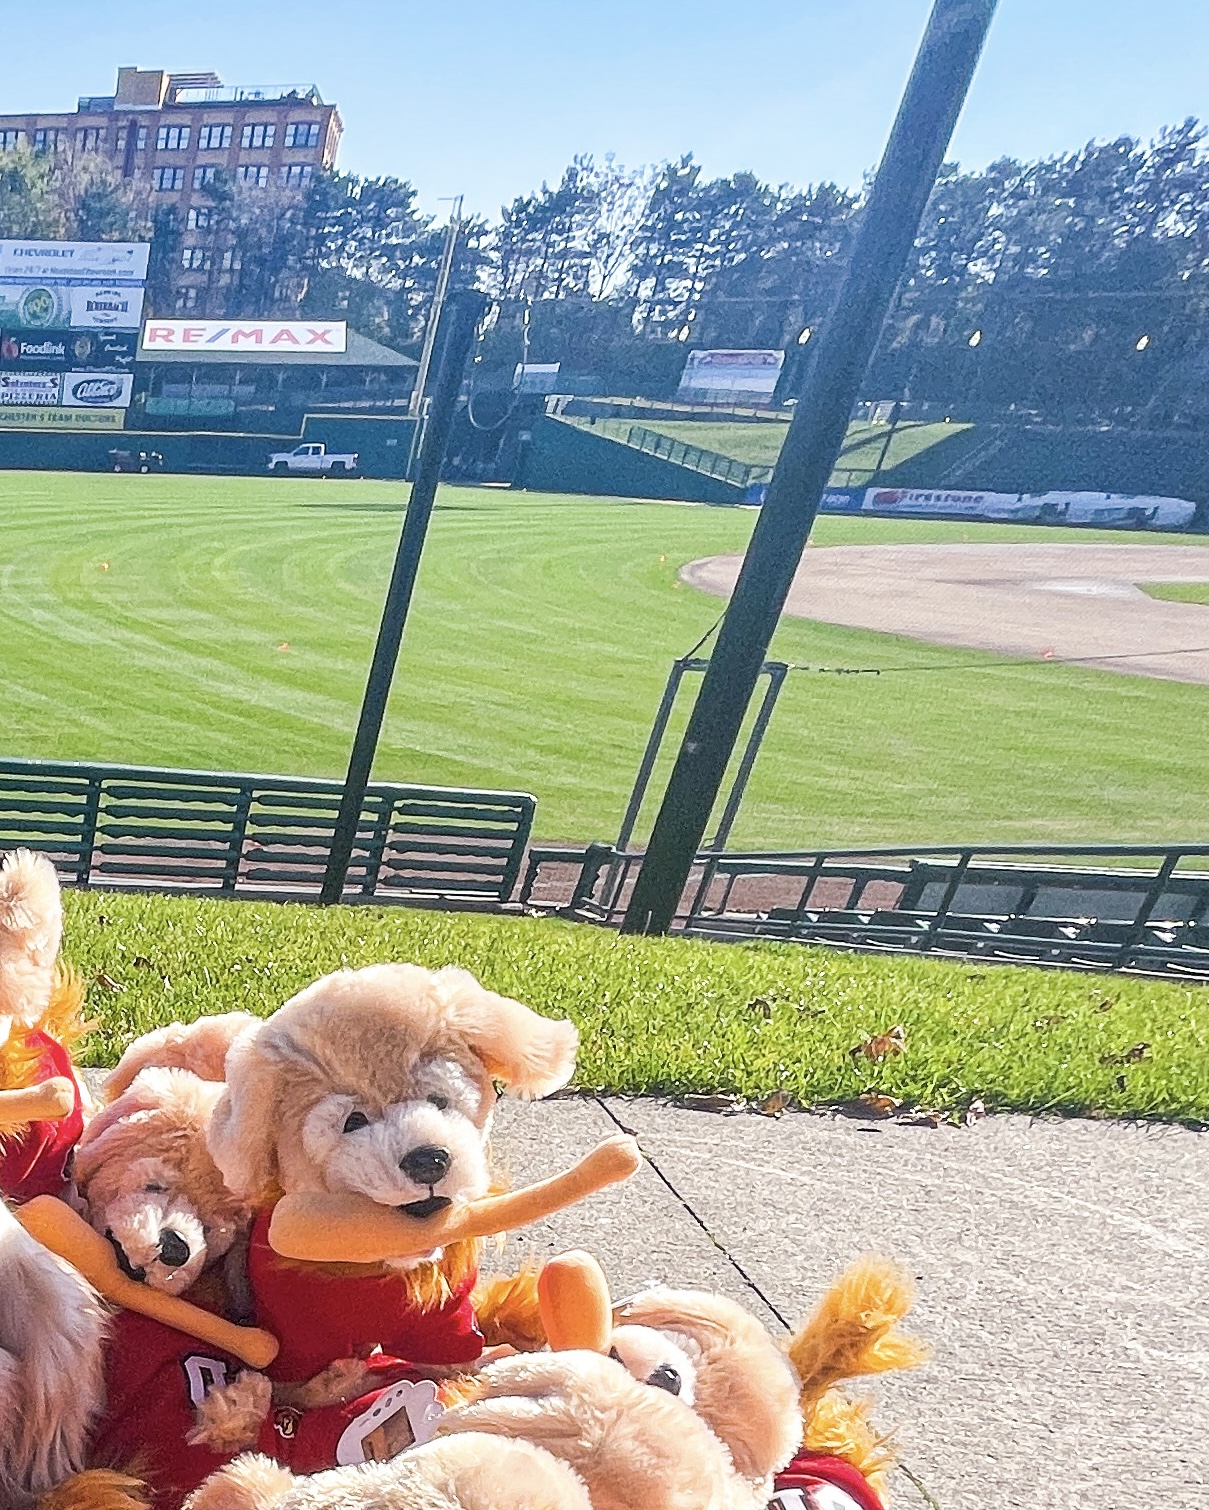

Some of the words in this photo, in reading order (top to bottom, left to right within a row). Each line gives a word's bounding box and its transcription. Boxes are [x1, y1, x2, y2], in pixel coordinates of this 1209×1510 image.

[13, 248, 75, 257] CHEVROLET
[148, 327, 334, 345] RE/MAX
[20, 342, 65, 355] Foodlink
[1, 392, 57, 401] PIZZERIA
